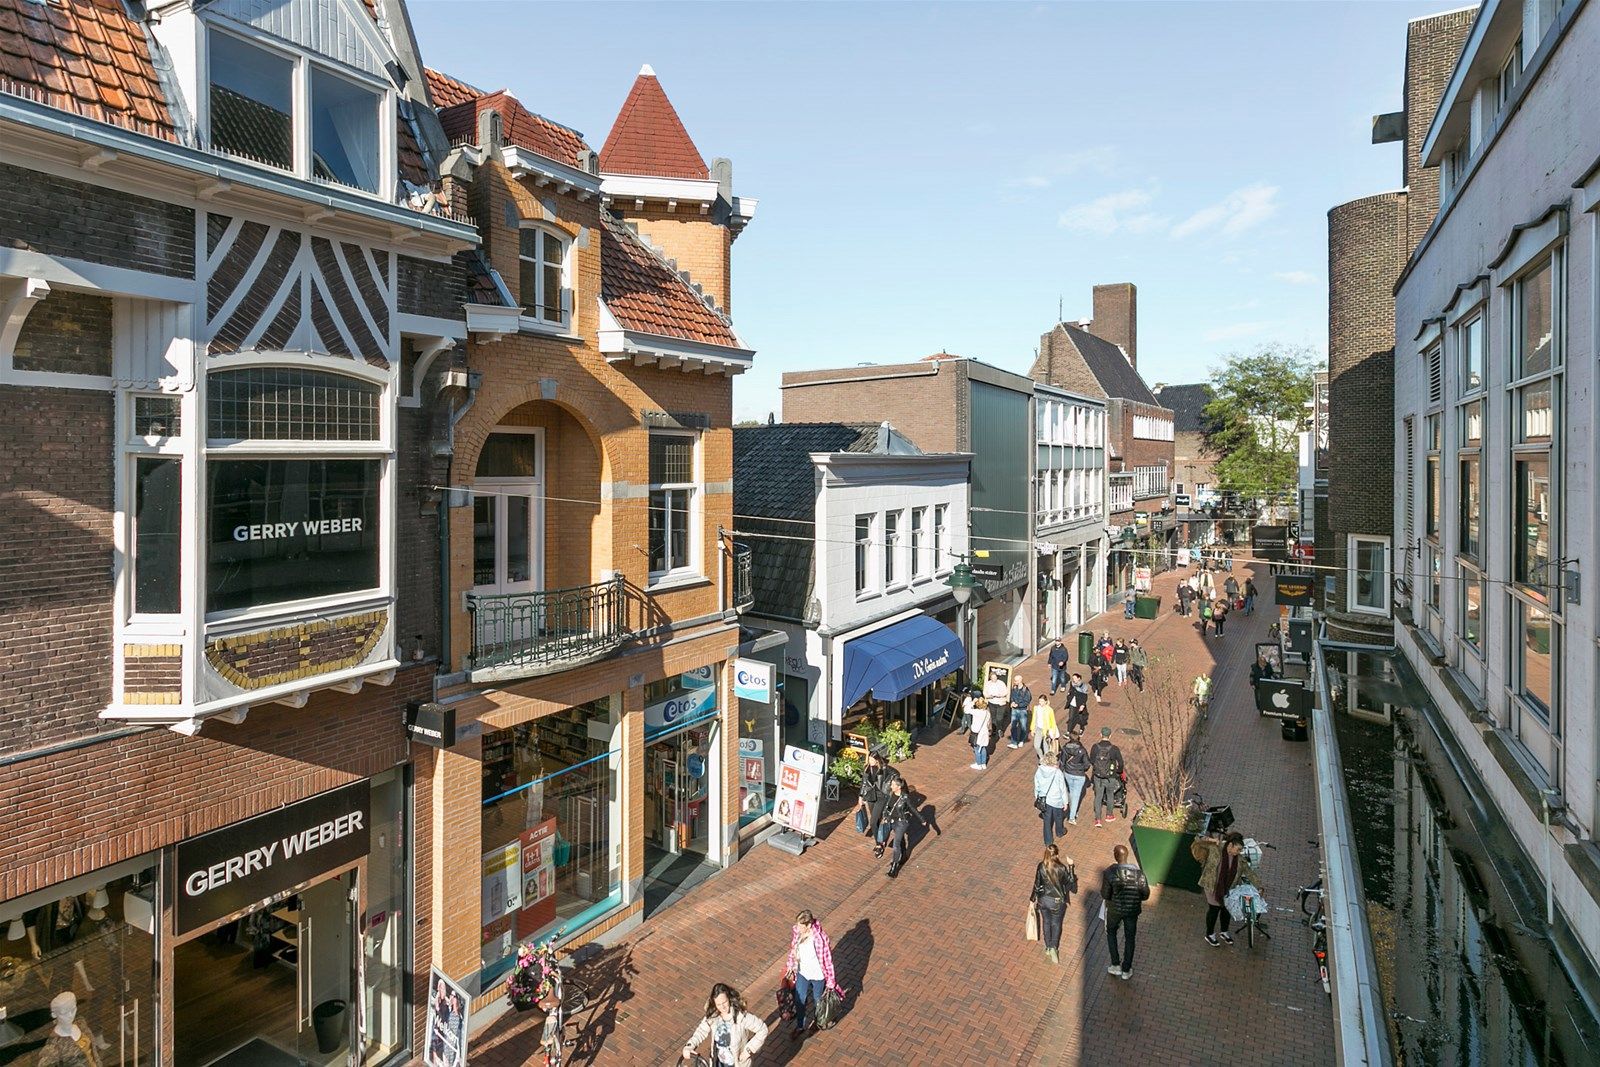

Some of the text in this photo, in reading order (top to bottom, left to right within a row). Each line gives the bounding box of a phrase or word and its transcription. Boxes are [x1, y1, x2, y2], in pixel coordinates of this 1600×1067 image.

[233, 517, 363, 542] GERRY WEBER
[738, 670, 767, 686] etos
[663, 698, 697, 722] etos
[424, 728, 442, 739] WEBER
[529, 825, 548, 841] ACTIE
[185, 810, 364, 897] GERRY WEBER
[525, 847, 539, 862] 1+1
